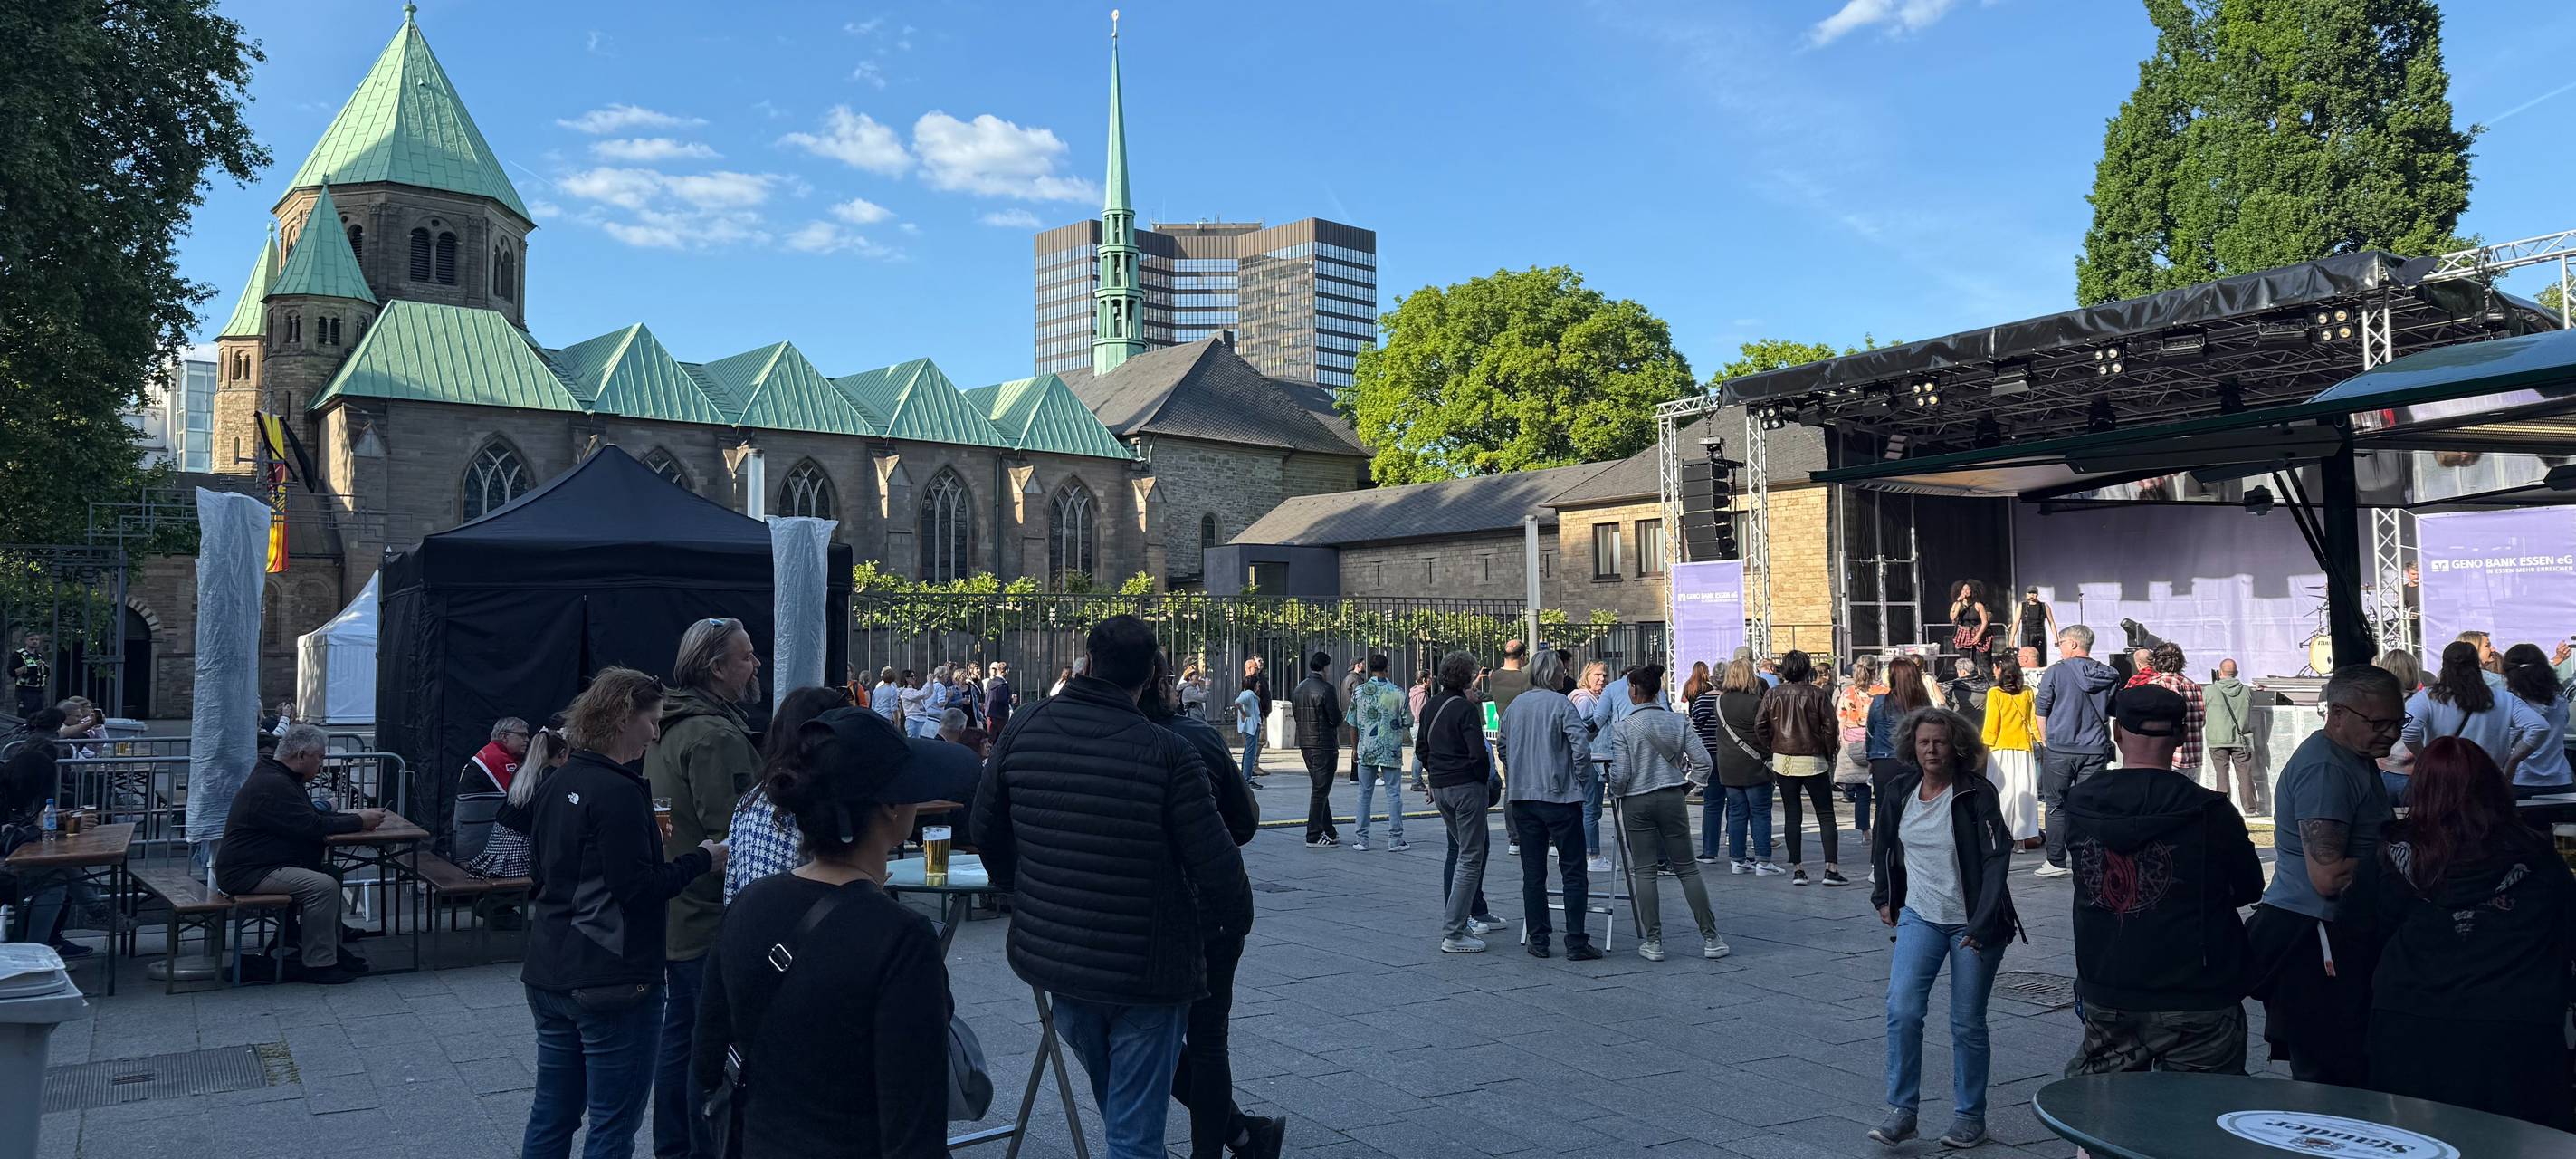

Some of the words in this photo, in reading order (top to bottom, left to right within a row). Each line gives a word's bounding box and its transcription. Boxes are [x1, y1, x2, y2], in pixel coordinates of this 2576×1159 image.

[2452, 560, 2483, 569] GENO
[2485, 558, 2516, 567] BANK
[2520, 556, 2554, 566] ESSEN
[2557, 555, 2573, 564] eG
[2264, 1120, 2416, 1154] Stauder
